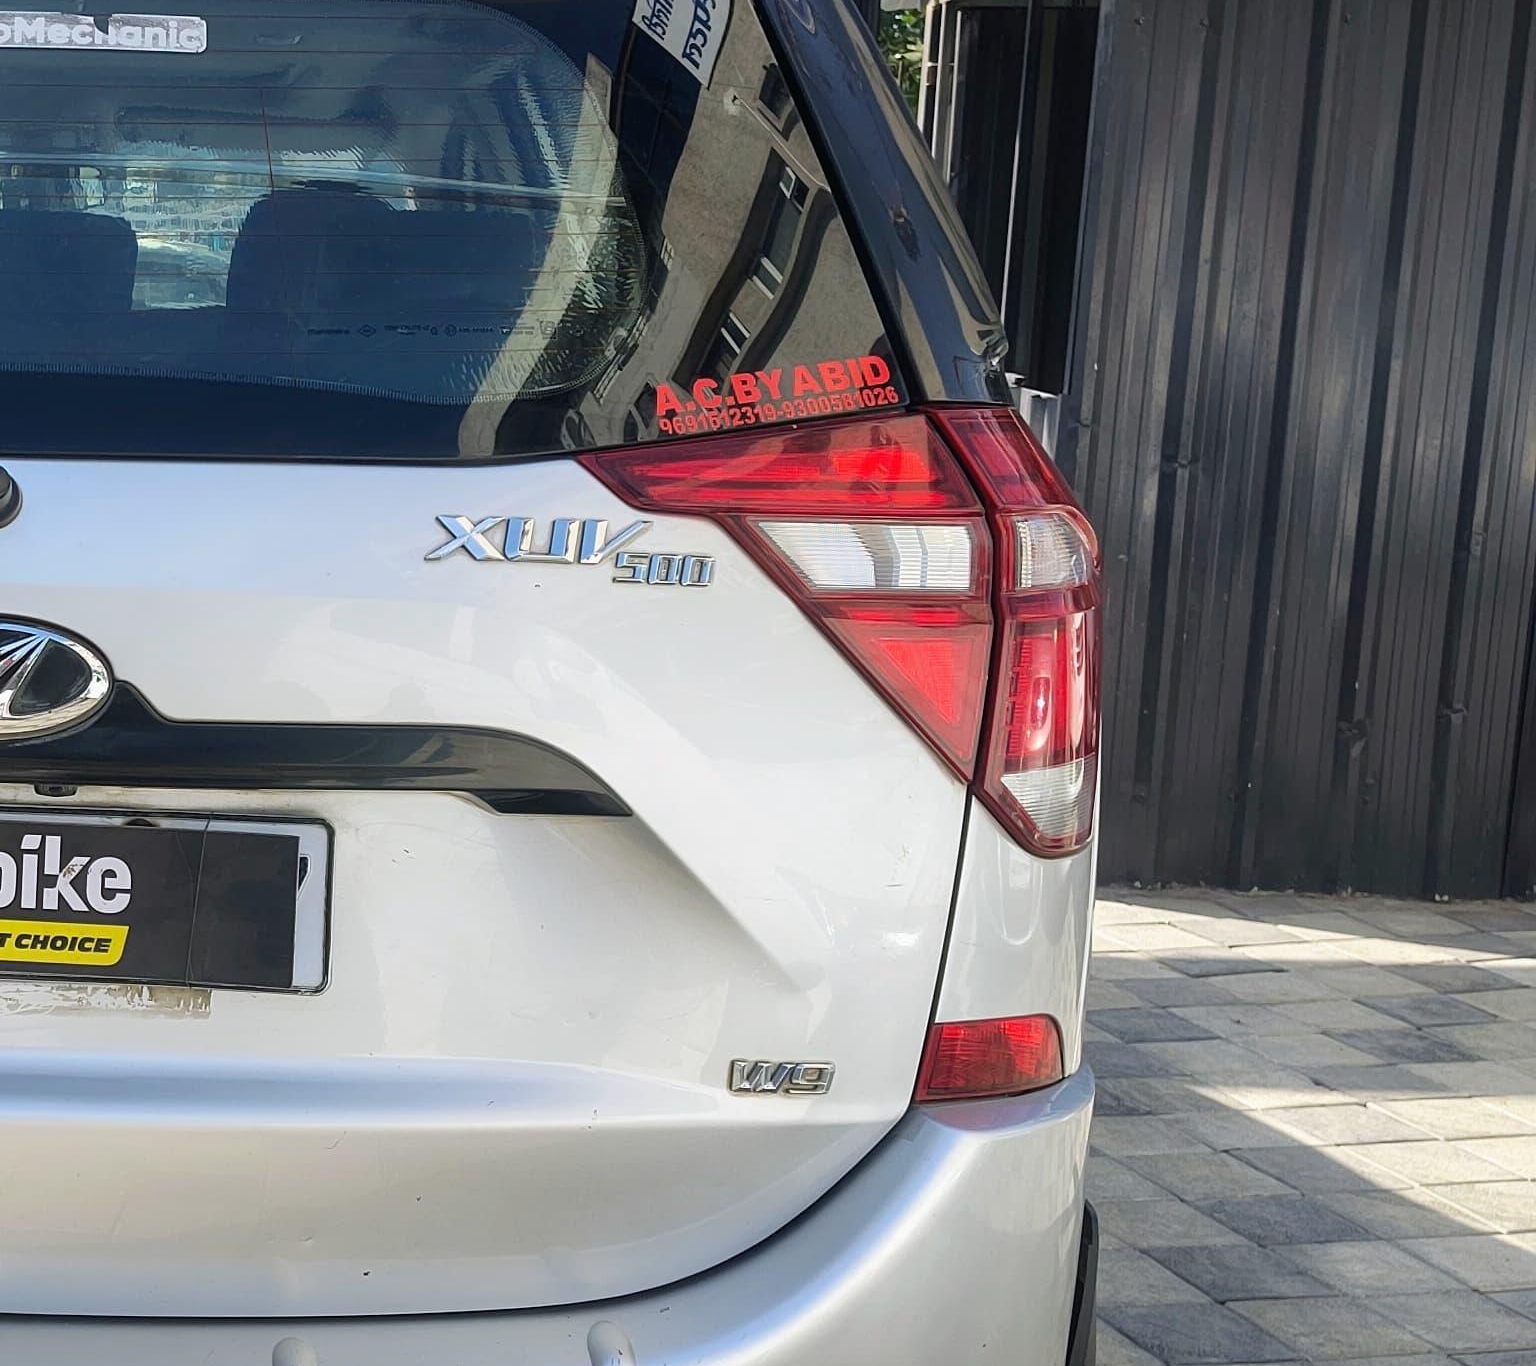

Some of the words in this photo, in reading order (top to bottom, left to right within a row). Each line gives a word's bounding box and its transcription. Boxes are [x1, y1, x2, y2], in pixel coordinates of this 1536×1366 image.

[793, 355, 891, 396] ABID
[14, 932, 112, 953] CHOICE
[728, 1059, 836, 1095] W9
